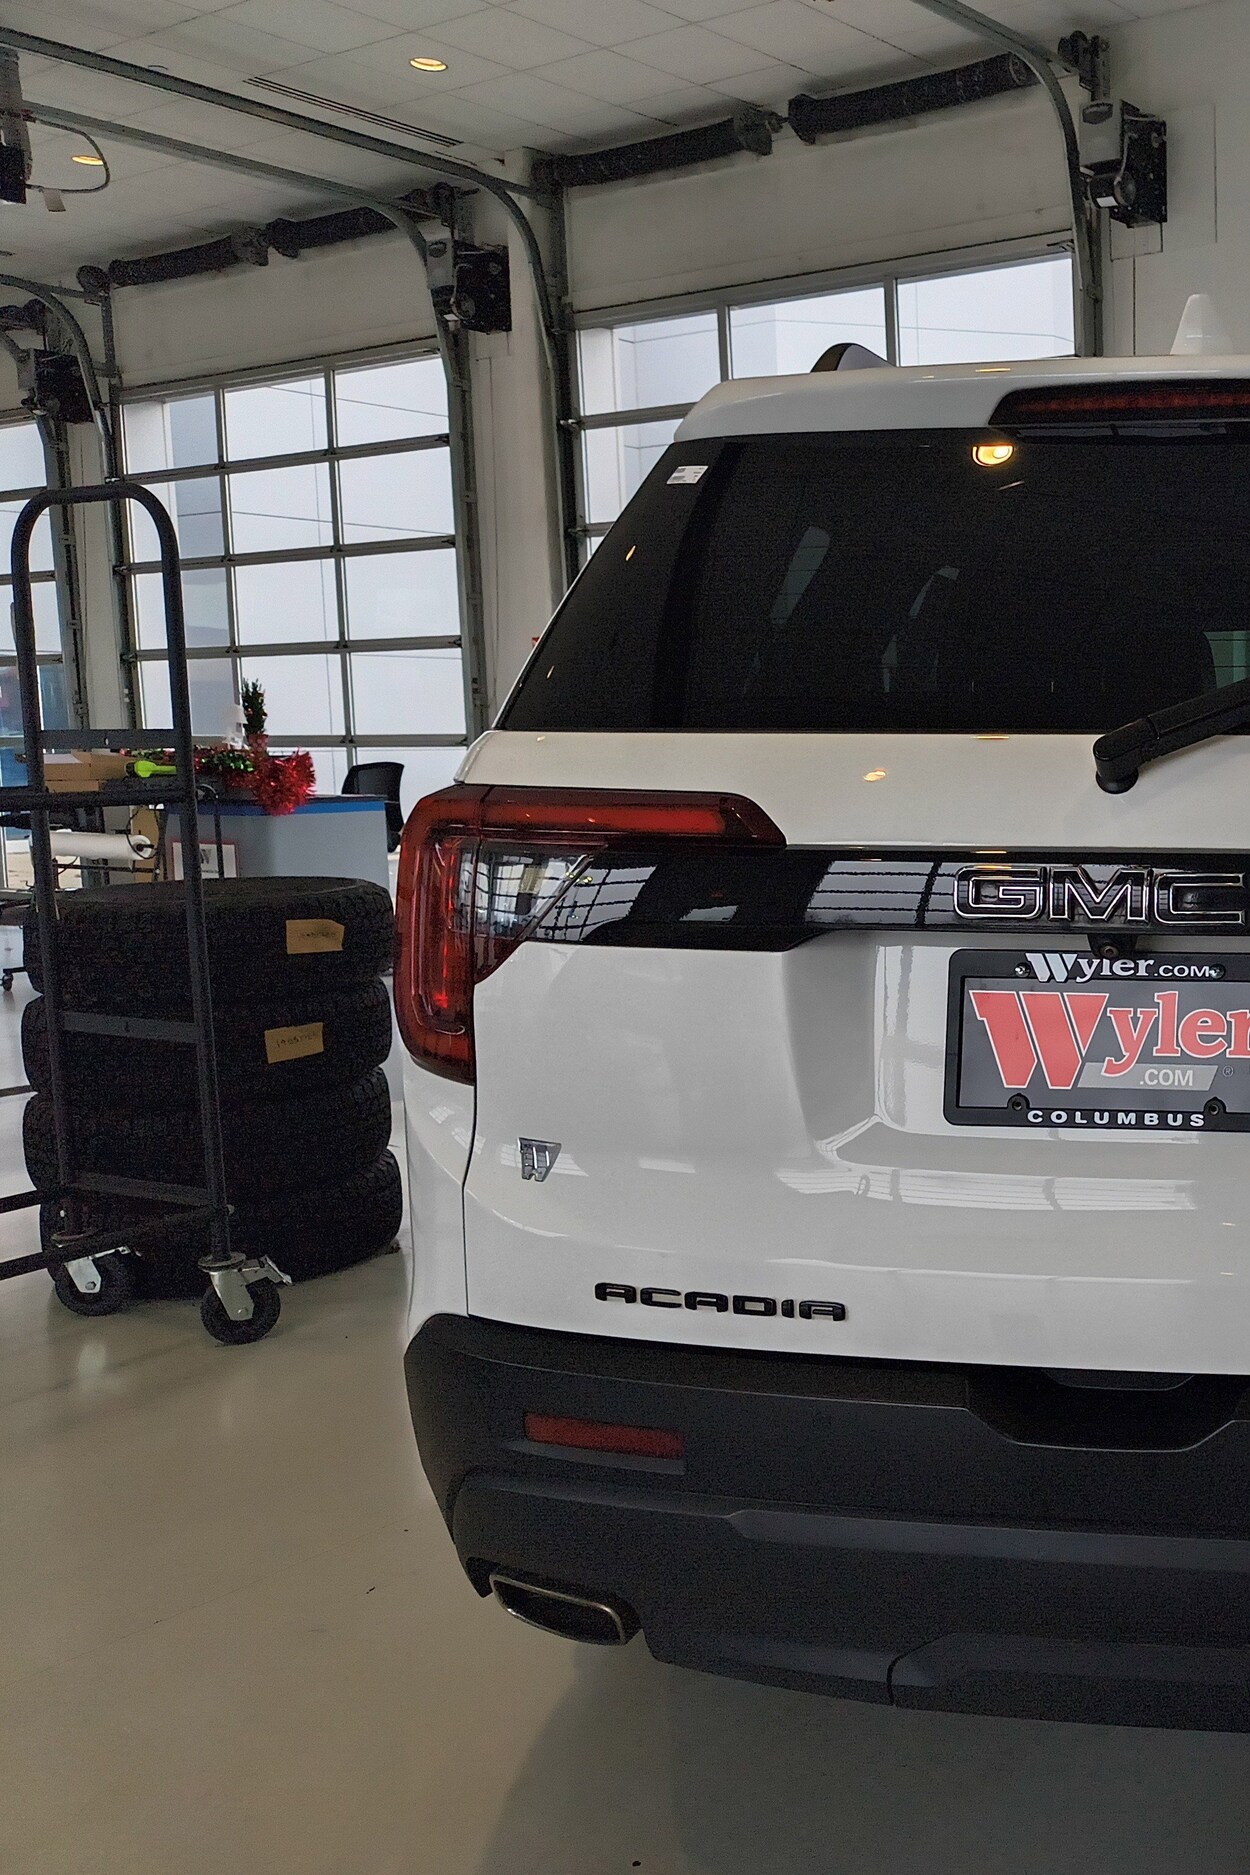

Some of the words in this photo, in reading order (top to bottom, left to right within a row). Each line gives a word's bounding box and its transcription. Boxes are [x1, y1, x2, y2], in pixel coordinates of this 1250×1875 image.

[953, 865, 1246, 927] GMC
[1027, 1109, 1205, 1128] COLUMBUS
[594, 1282, 846, 1322] ACADIA
